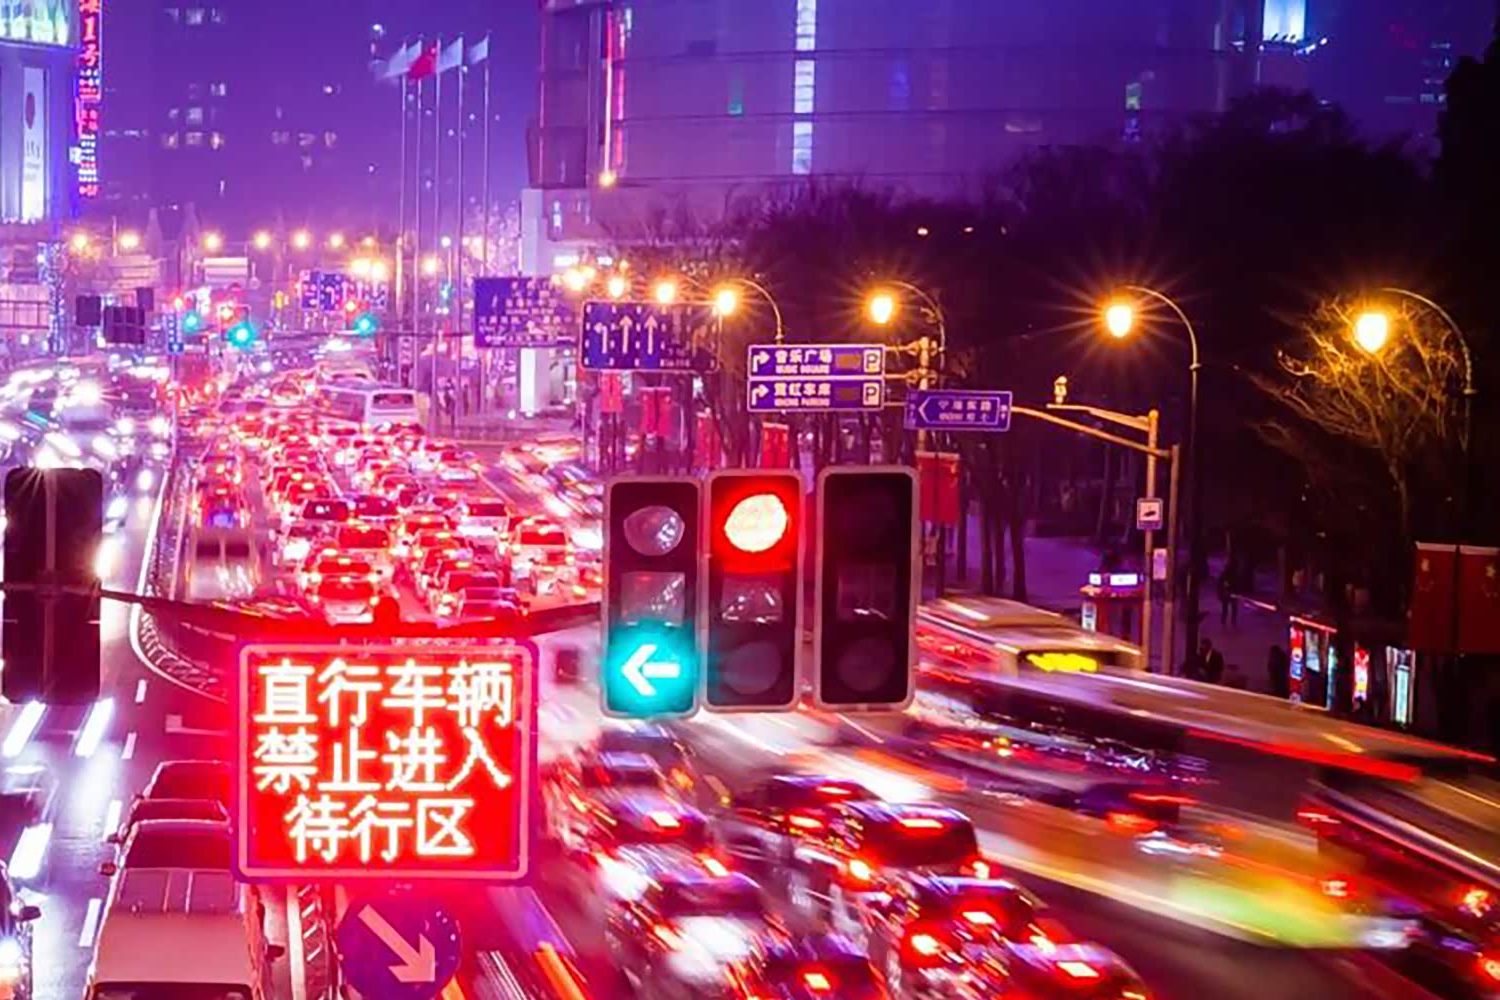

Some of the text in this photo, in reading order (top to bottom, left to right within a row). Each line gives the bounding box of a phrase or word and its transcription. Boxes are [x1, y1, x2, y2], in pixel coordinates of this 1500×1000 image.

[253, 658, 513, 727] 直行车辆
[253, 726, 512, 793] 禁止进入
[284, 794, 474, 863] 待行区
